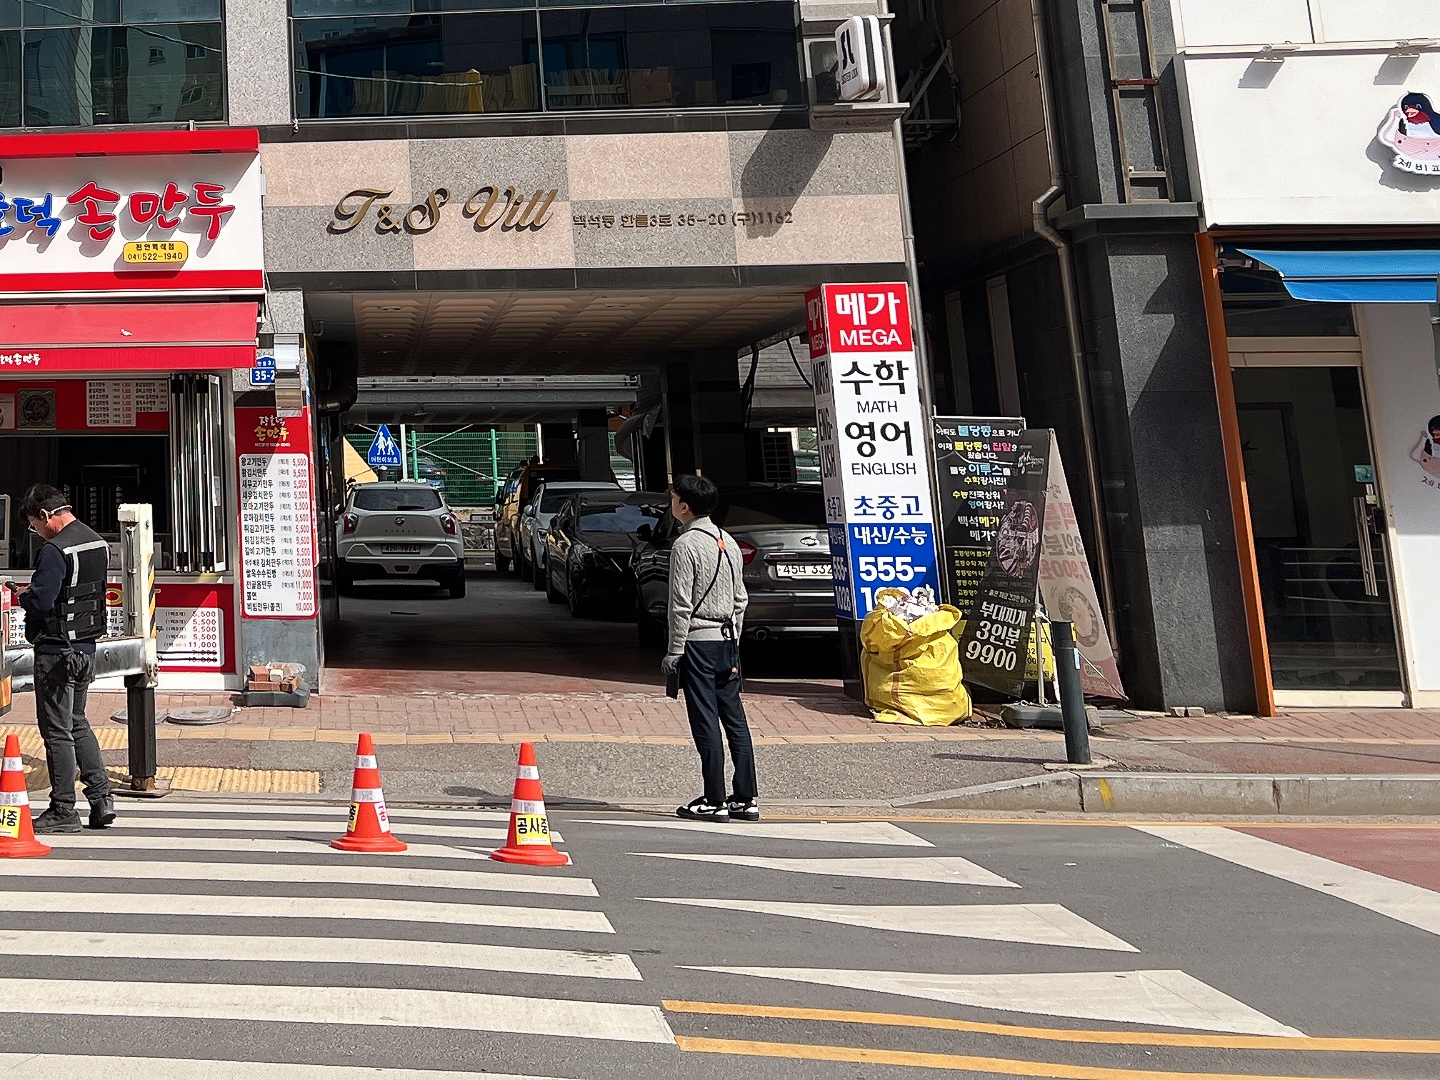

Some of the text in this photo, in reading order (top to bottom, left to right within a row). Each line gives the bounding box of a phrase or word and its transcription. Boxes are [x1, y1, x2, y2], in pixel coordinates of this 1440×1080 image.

[67, 181, 236, 241] 손만두
[326, 184, 559, 235] T&S Vill
[572, 214, 616, 229] 백석동
[677, 212, 727, 227] 35-20
[835, 291, 901, 326] 메가
[840, 328, 903, 347] MEGA
[840, 360, 909, 395] 수학
[856, 400, 898, 413] MATH
[844, 421, 914, 458] 영어
[851, 463, 917, 476] ENGLISH
[853, 495, 924, 520] 초중고
[853, 526, 928, 546] 내신/수능
[858, 556, 927, 582] 555-
[975, 620, 1021, 649] 3인분
[965, 640, 1017, 672] 9900
[517, 817, 548, 835] 공사중
